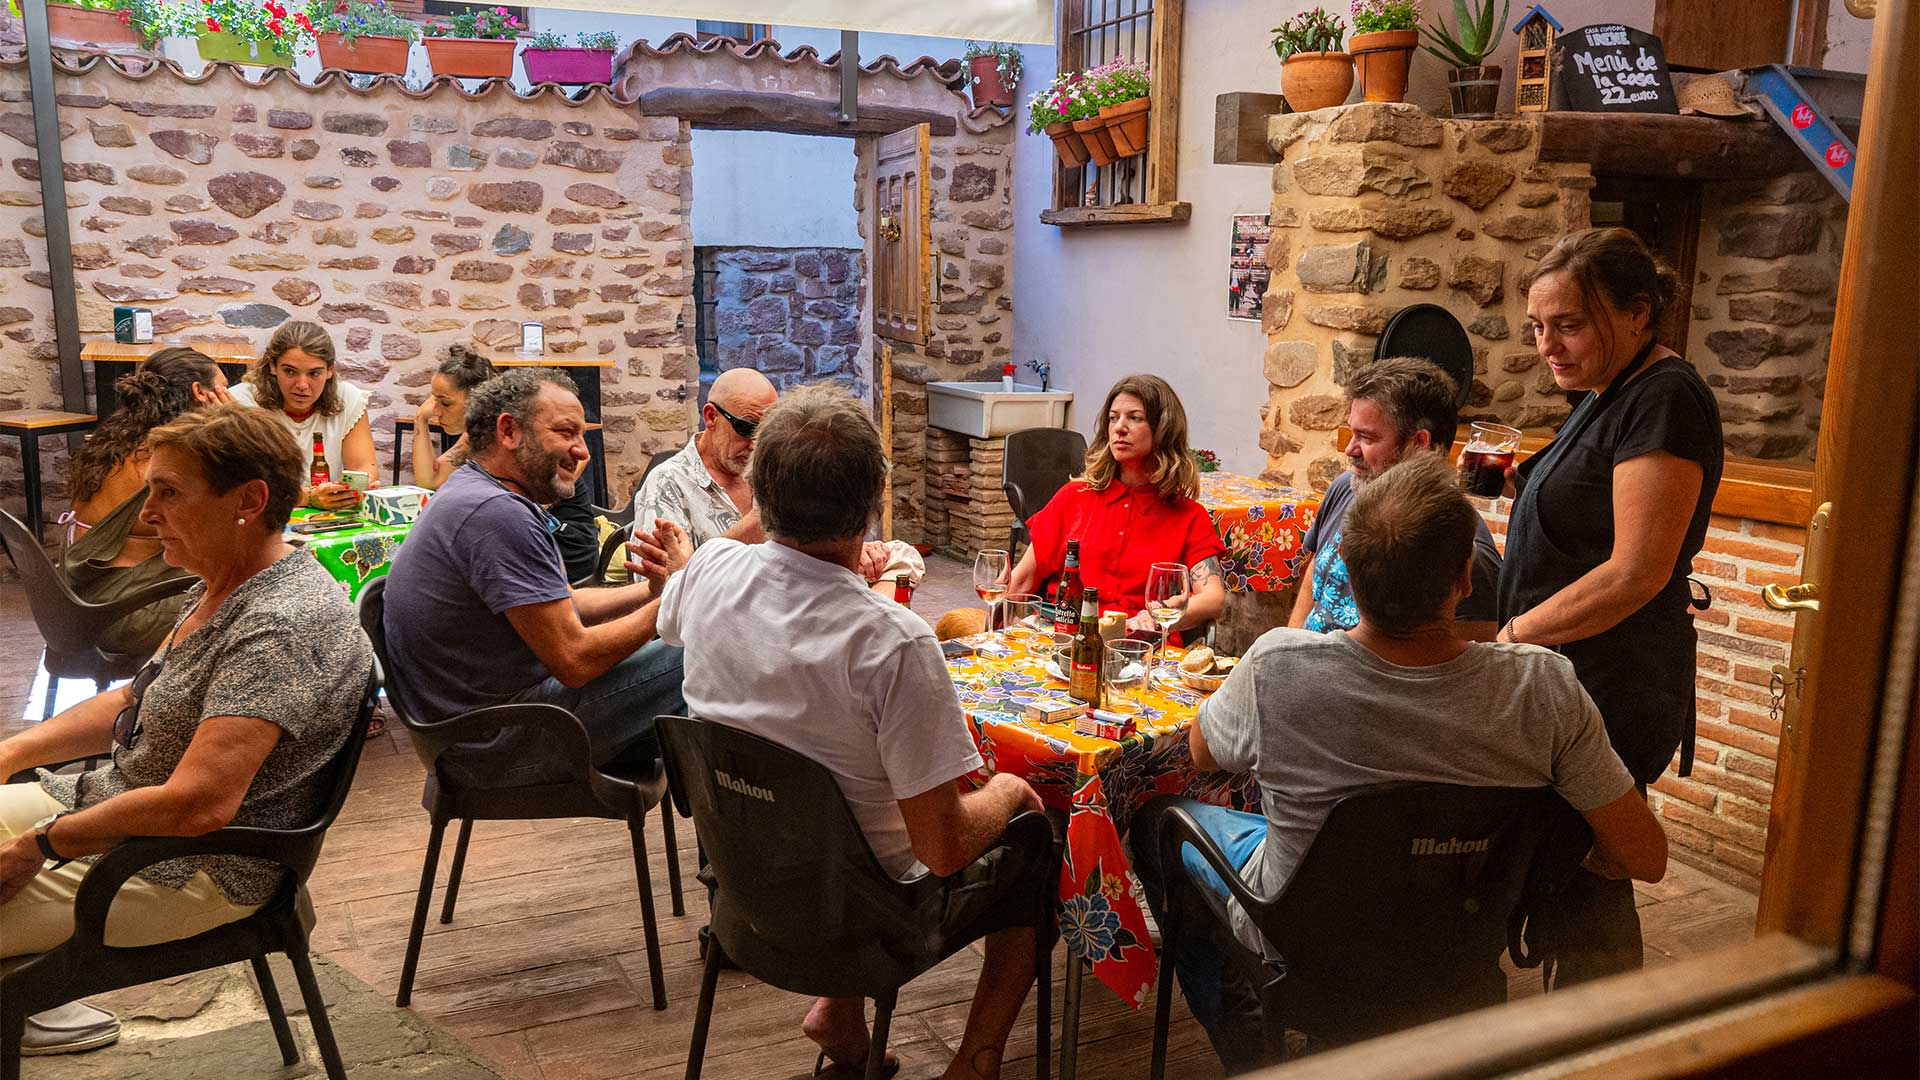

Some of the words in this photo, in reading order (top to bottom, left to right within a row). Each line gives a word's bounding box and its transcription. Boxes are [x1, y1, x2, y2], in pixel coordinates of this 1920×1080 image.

[1572, 49, 1634, 74] Menú
[1636, 47, 1659, 72] de
[1592, 74, 1615, 89] la
[1616, 72, 1661, 87] casa
[1600, 86, 1632, 105] 22
[1630, 90, 1659, 103] euros
[1055, 615, 1075, 625] alicia
[714, 768, 776, 803] Mahou
[1410, 837, 1489, 855] Mahou
